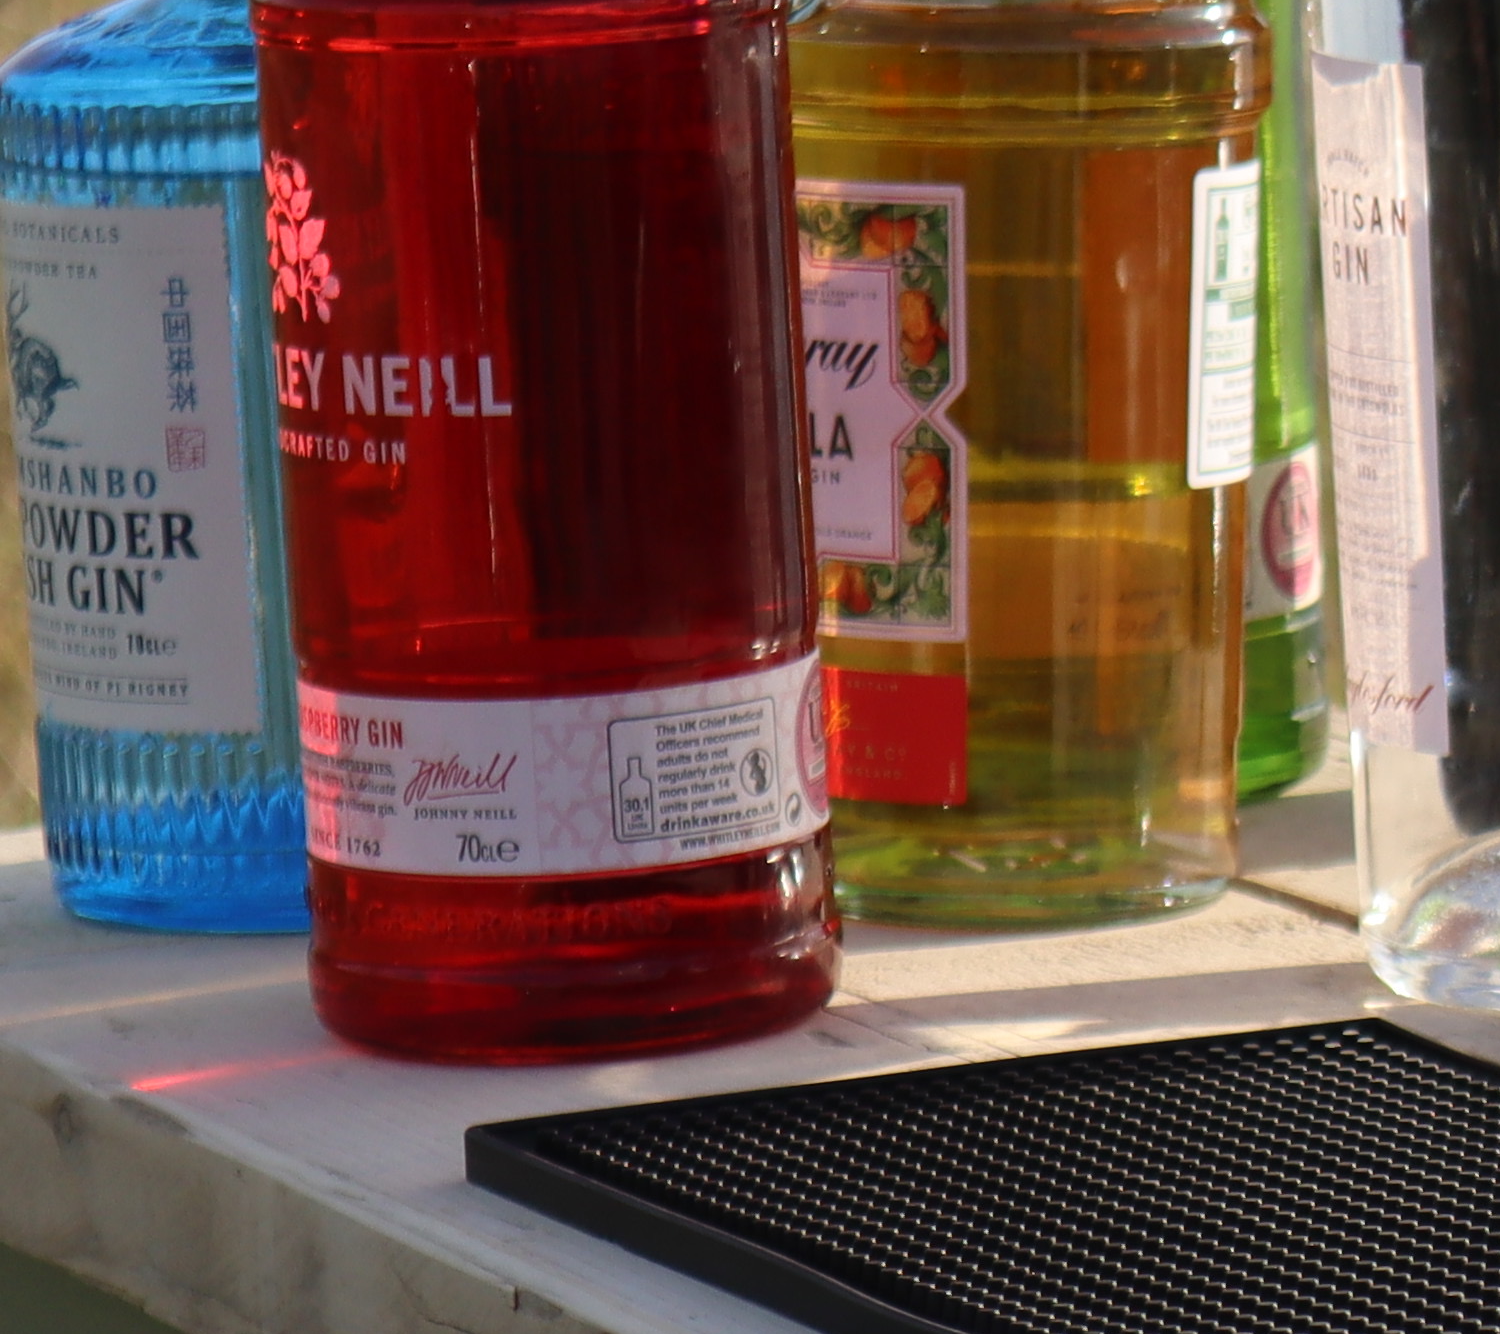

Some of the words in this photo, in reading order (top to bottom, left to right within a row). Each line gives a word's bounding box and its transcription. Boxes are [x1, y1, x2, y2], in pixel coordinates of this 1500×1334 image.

[1332, 240, 1369, 286] GIN
[363, 441, 407, 465] GIN
[367, 719, 404, 750] GIN
[656, 724, 678, 737] The
[679, 721, 698, 734] UK
[698, 717, 727, 731] Chief
[656, 738, 700, 752] Officers
[702, 727, 761, 746] recommend
[656, 753, 692, 768] adults
[694, 751, 709, 763] do
[711, 748, 729, 760] not
[657, 766, 708, 784] regularly
[709, 761, 736, 776] drink
[658, 787, 689, 800] more
[690, 781, 716, 795] than
[718, 778, 731, 789] 14
[414, 808, 467, 821] JOHNNY
[473, 809, 518, 820] NEILL
[624, 798, 650, 814] 30.1
[659, 801, 688, 815] units
[690, 798, 709, 811] per
[711, 793, 738, 806] week
[660, 802, 776, 834] drinkaware.co.uk
[346, 837, 381, 858] 1762
